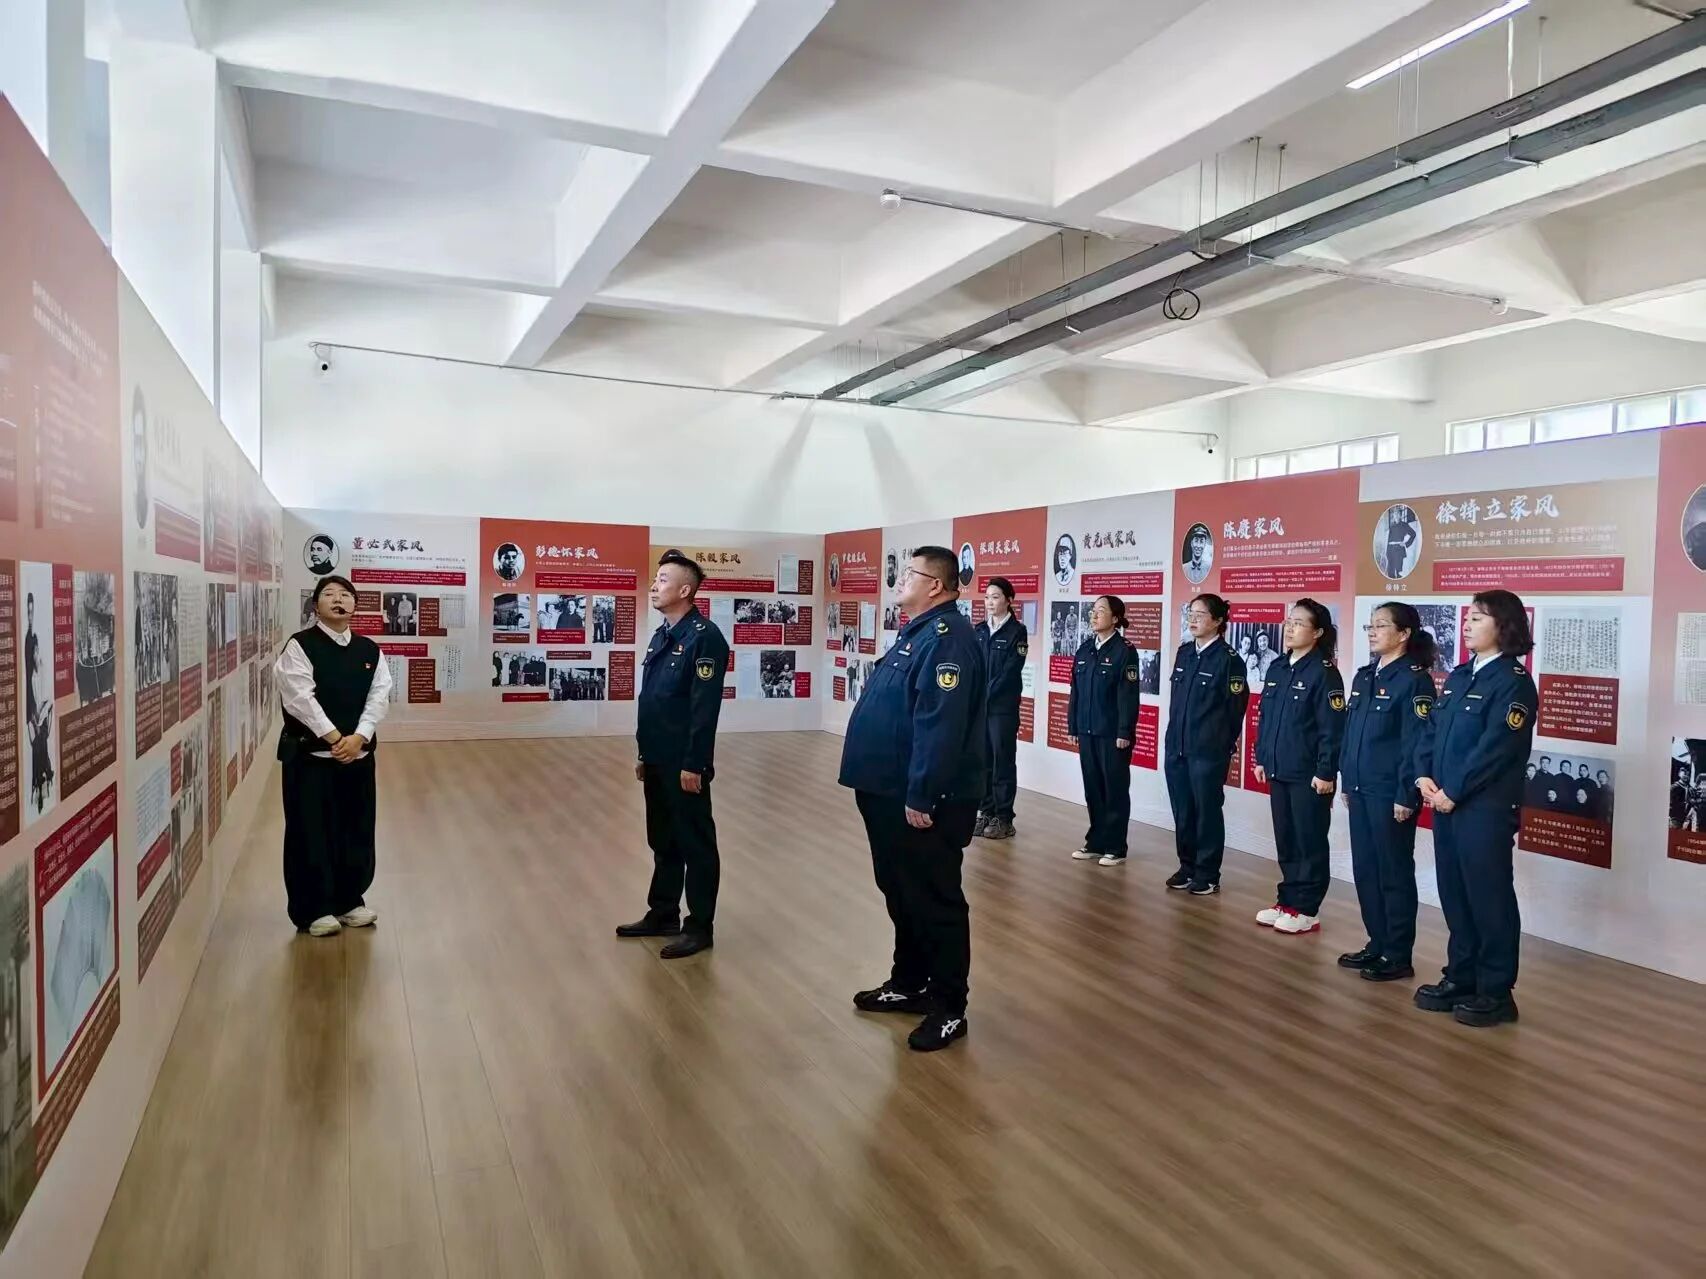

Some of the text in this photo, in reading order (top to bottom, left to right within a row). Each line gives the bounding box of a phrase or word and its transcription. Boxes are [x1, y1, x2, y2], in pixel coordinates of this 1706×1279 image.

[1435, 493, 1560, 525] 徐特立家风
[352, 536, 424, 552] 董必武家风
[1082, 530, 1137, 550] 黄克诚家风
[535, 545, 599, 560] 彭德怀家风
[695, 552, 741, 564] 陈毅家风
